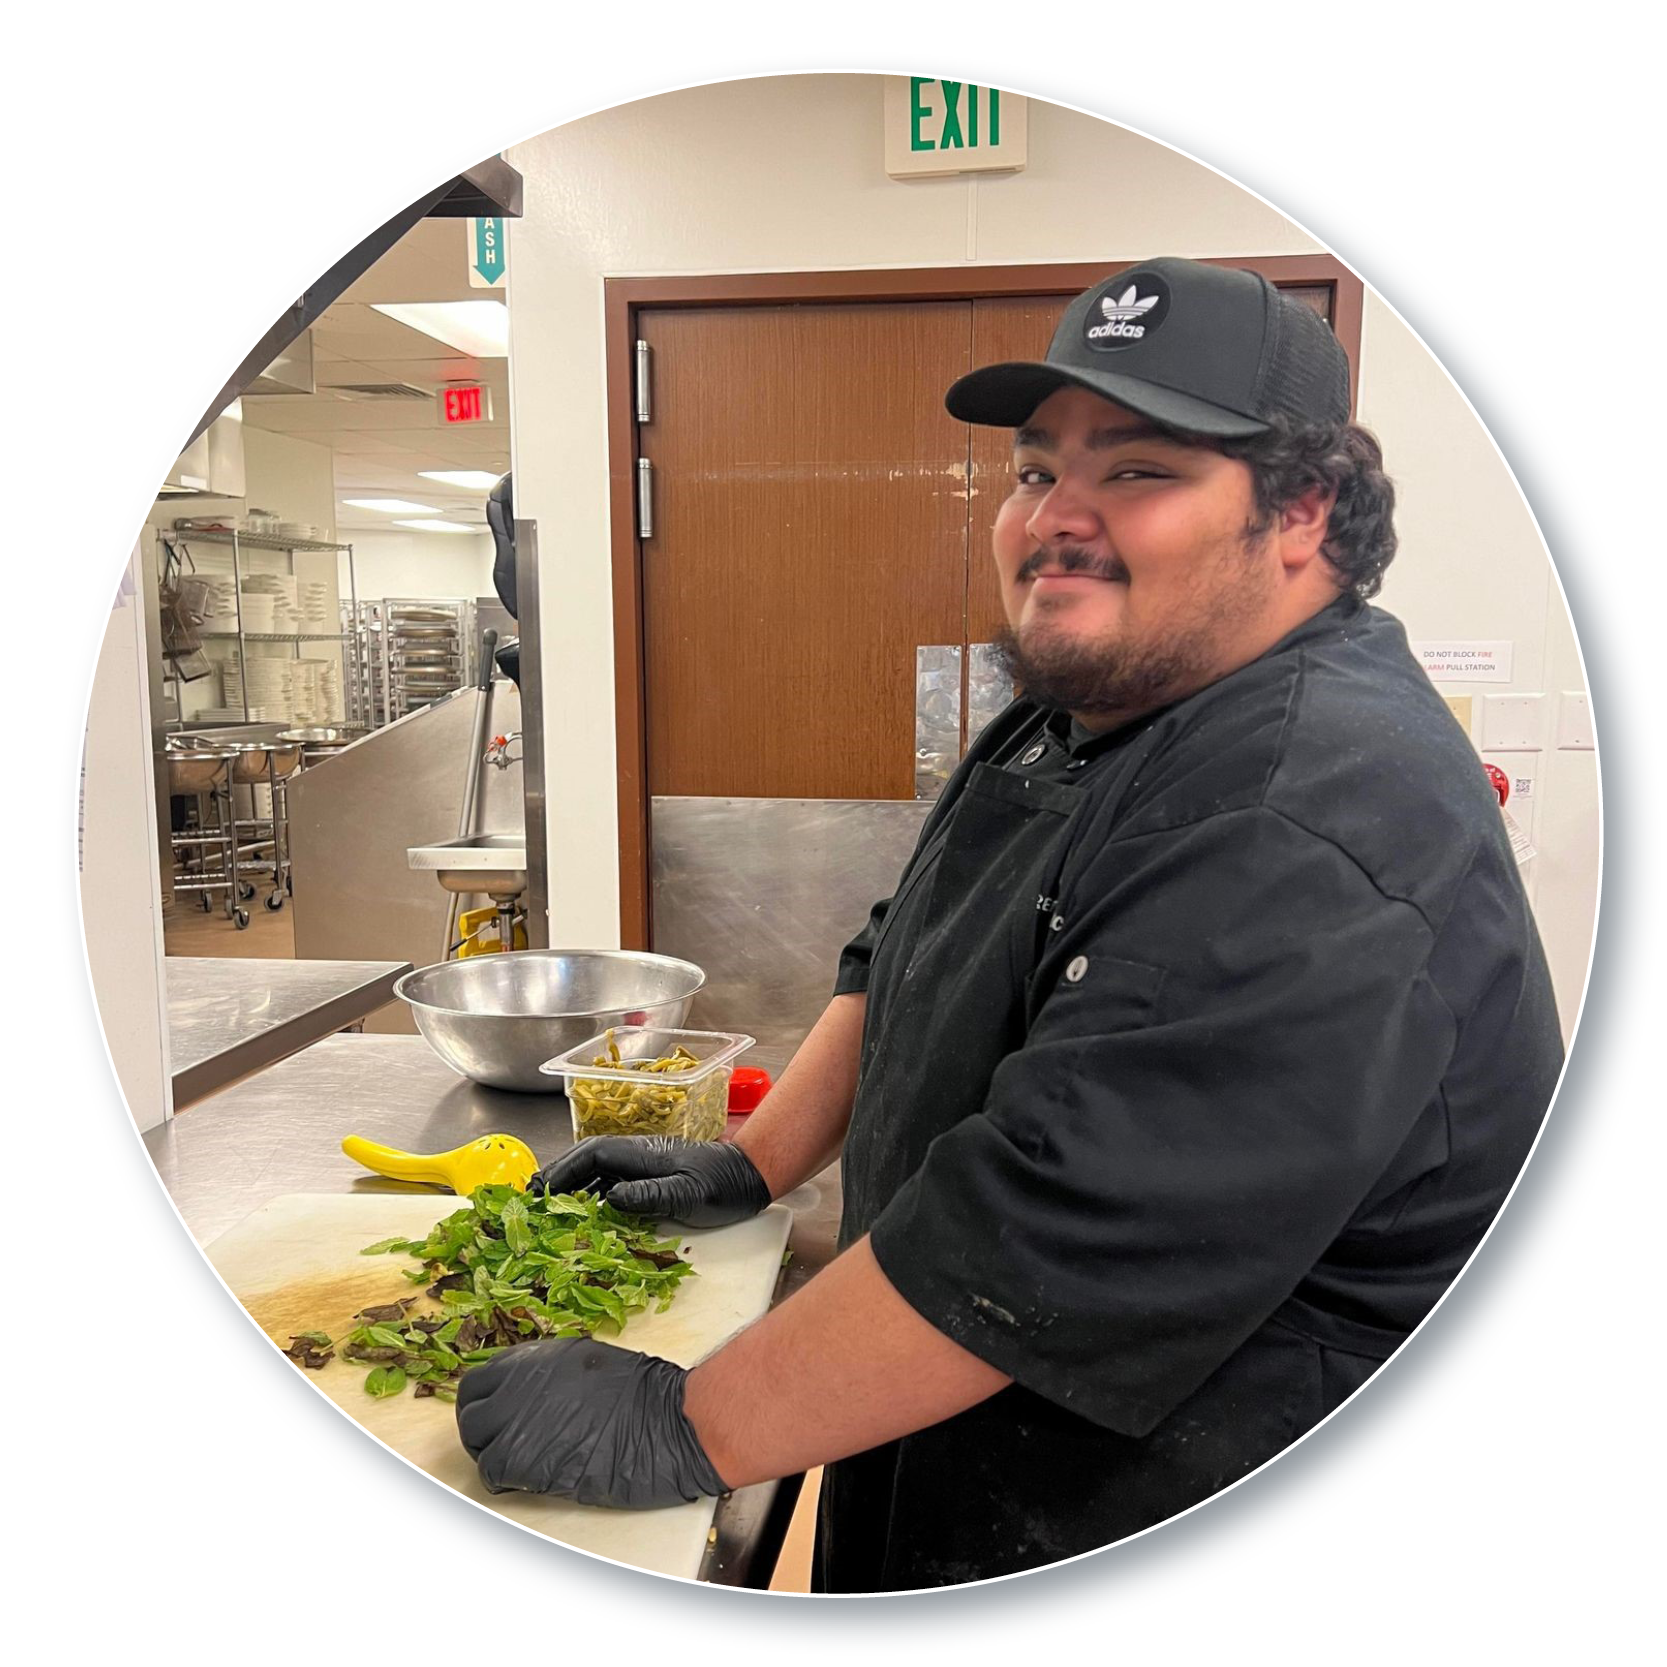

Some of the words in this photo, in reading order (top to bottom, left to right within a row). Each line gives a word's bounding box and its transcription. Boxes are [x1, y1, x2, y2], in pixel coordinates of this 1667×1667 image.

[484, 217, 496, 264] ASH
[1088, 321, 1145, 338] adidas
[444, 388, 481, 422] EXIT
